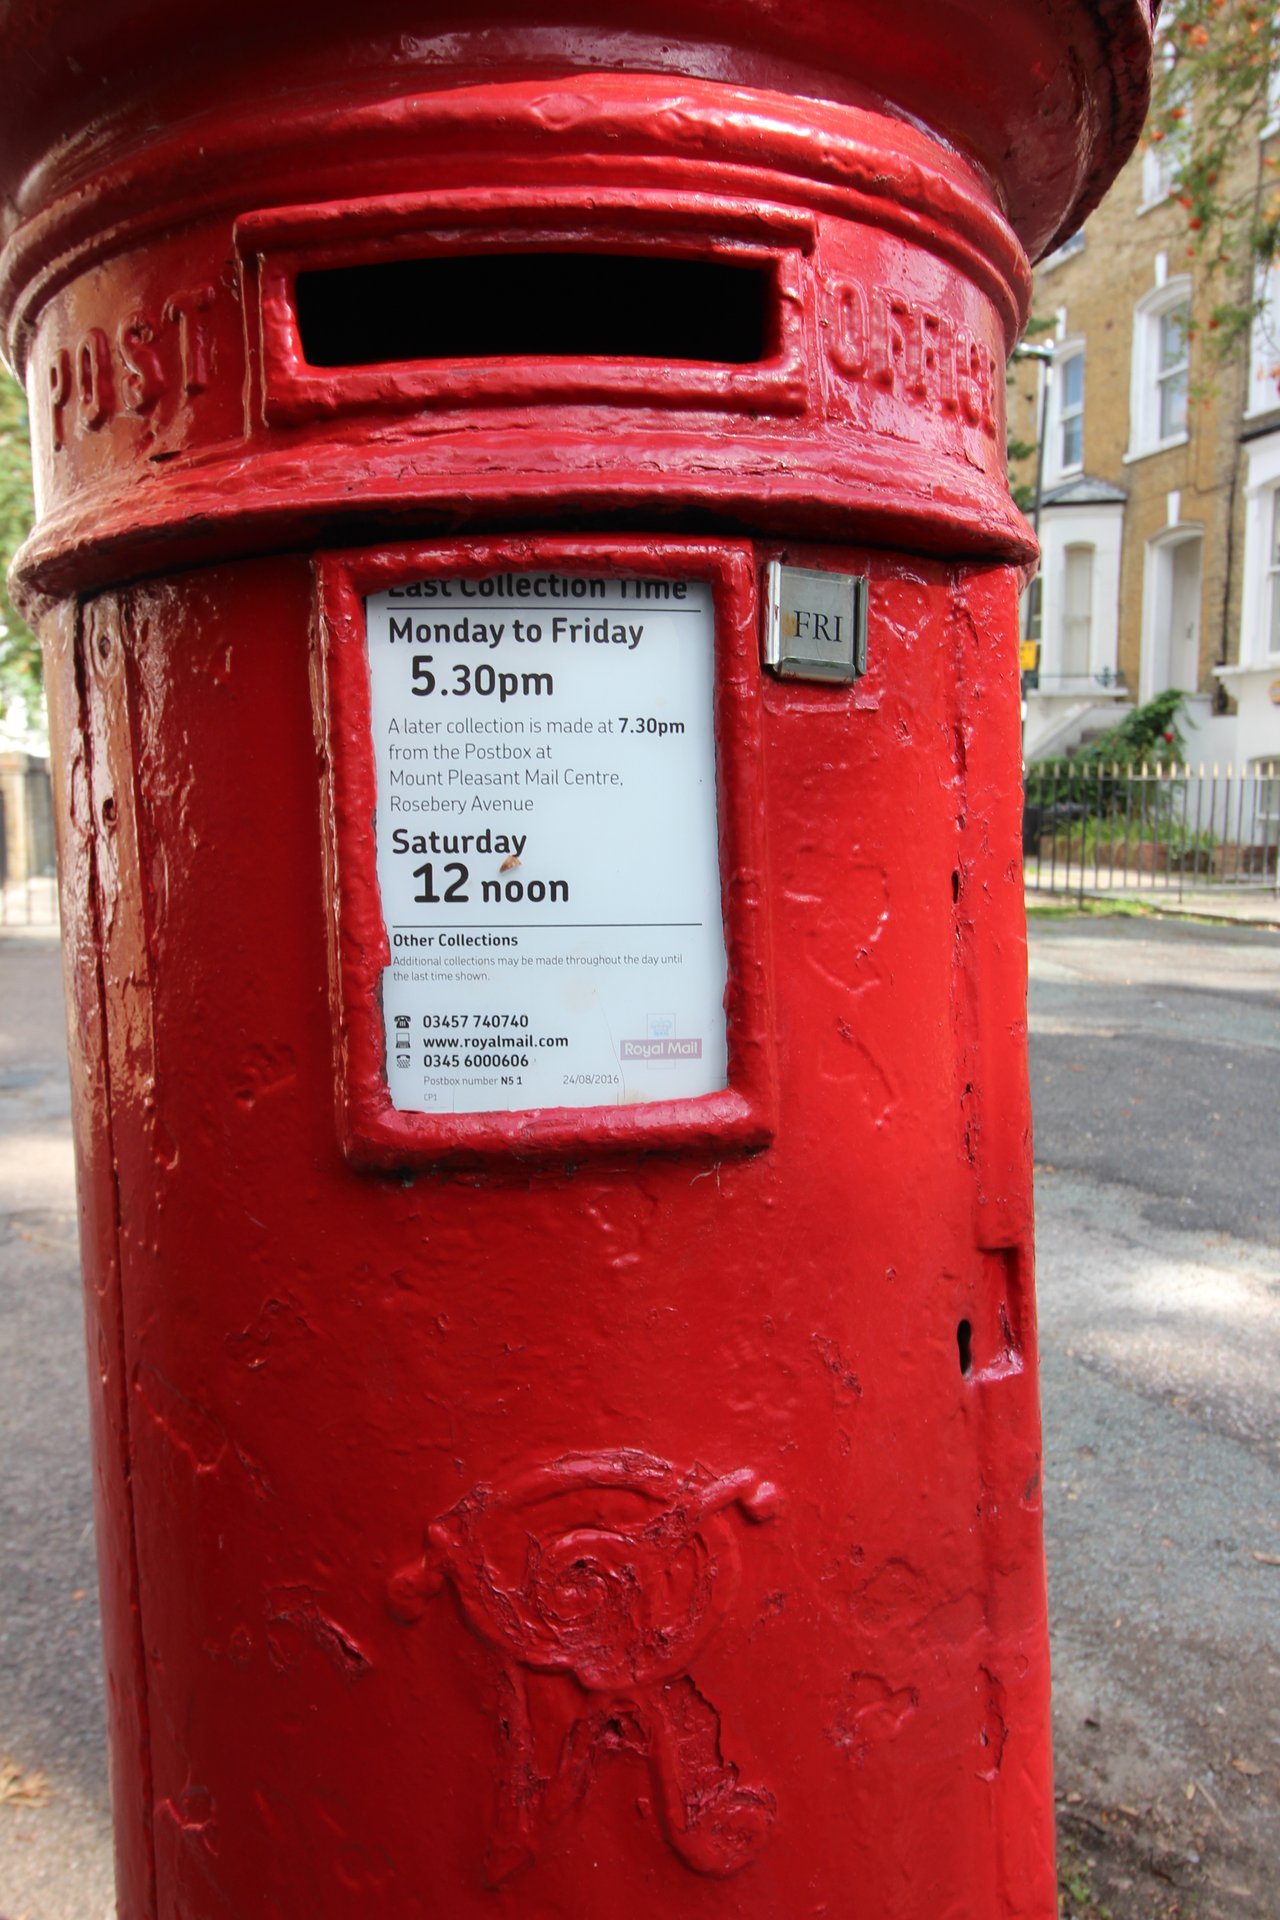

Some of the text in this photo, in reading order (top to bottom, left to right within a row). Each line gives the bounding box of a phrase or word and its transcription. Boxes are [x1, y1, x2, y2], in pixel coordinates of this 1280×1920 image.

[459, 573, 606, 598] Collection
[389, 617, 643, 650] Monday to Friday
[793, 610, 844, 643] FRI
[412, 655, 553, 703] 5.30pm
[388, 717, 684, 737] A later collection is made at 7.30pm
[389, 743, 552, 760] from the Postbox at
[390, 769, 623, 786] Mount Pleasant Mail Centre,
[391, 795, 533, 815] Rosebery Avenue
[392, 828, 527, 858] Saturday
[413, 862, 569, 904] 12 noon
[394, 933, 518, 947] Other Collections
[392, 954, 682, 968] Additional collections may be made throughout the day until
[393, 969, 490, 981] the last time shown.
[423, 1015, 528, 1028] 03457 740740
[423, 1034, 568, 1050] www.royalmail.com
[624, 1041, 698, 1057] Royal Mail
[424, 1054, 528, 1067] 0345 6000606
[424, 1074, 522, 1086] Postbox number N5 1
[562, 1074, 620, 1086] 24/08/2016
